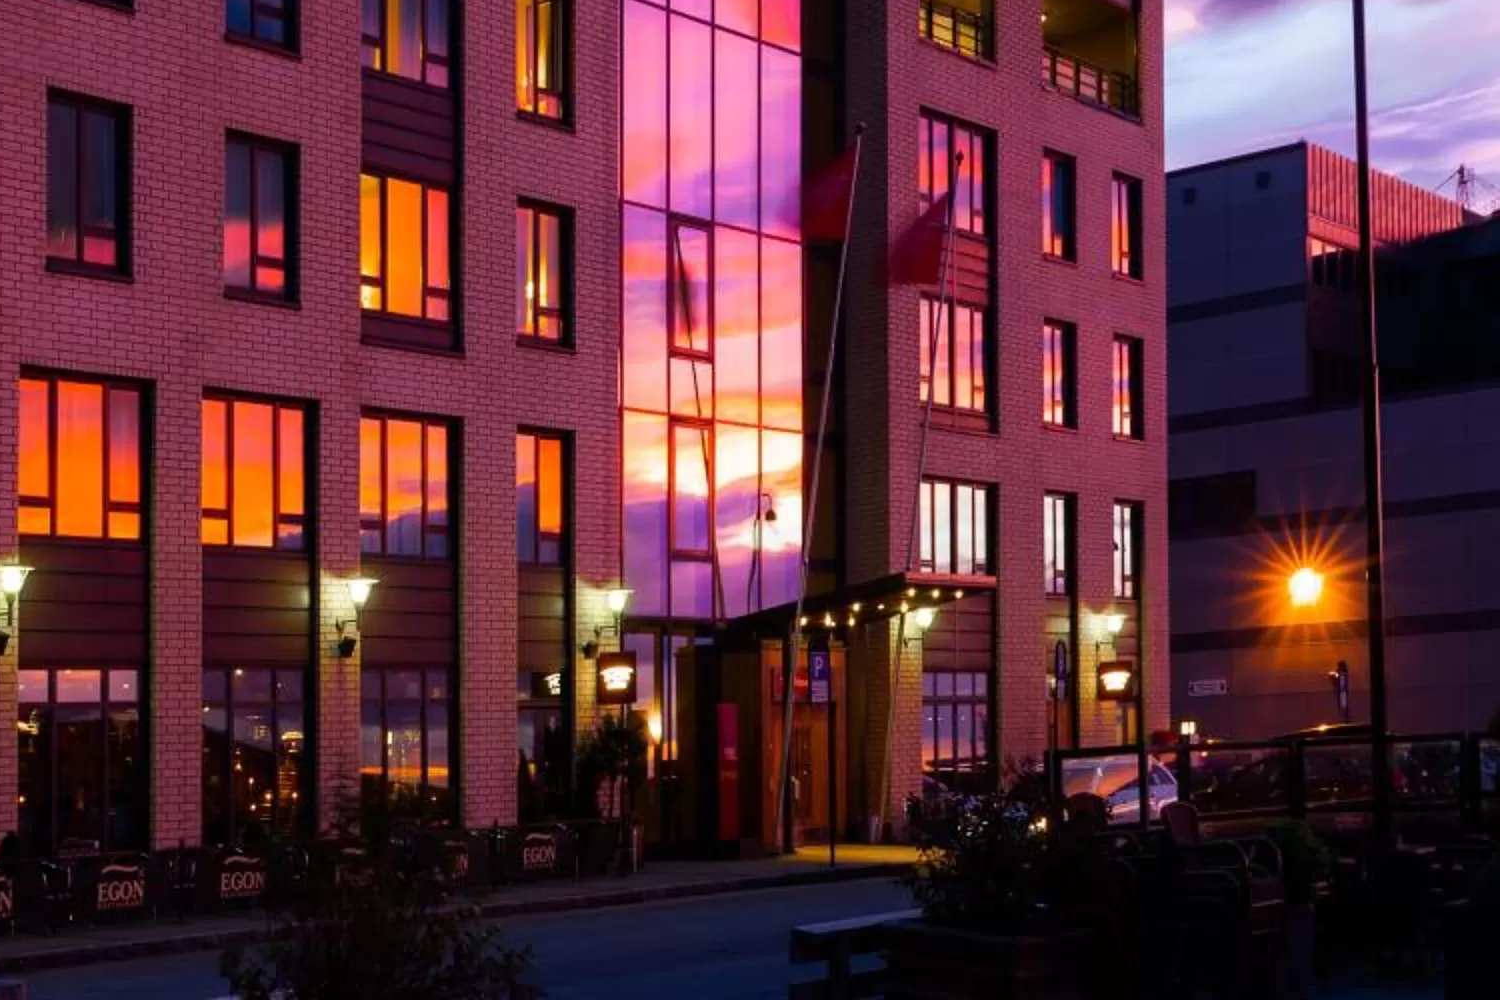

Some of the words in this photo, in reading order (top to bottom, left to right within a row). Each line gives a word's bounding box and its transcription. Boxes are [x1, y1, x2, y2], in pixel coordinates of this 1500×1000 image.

[815, 655, 824, 678] P
[97, 880, 145, 902] EGON
[221, 871, 265, 891] EGON
